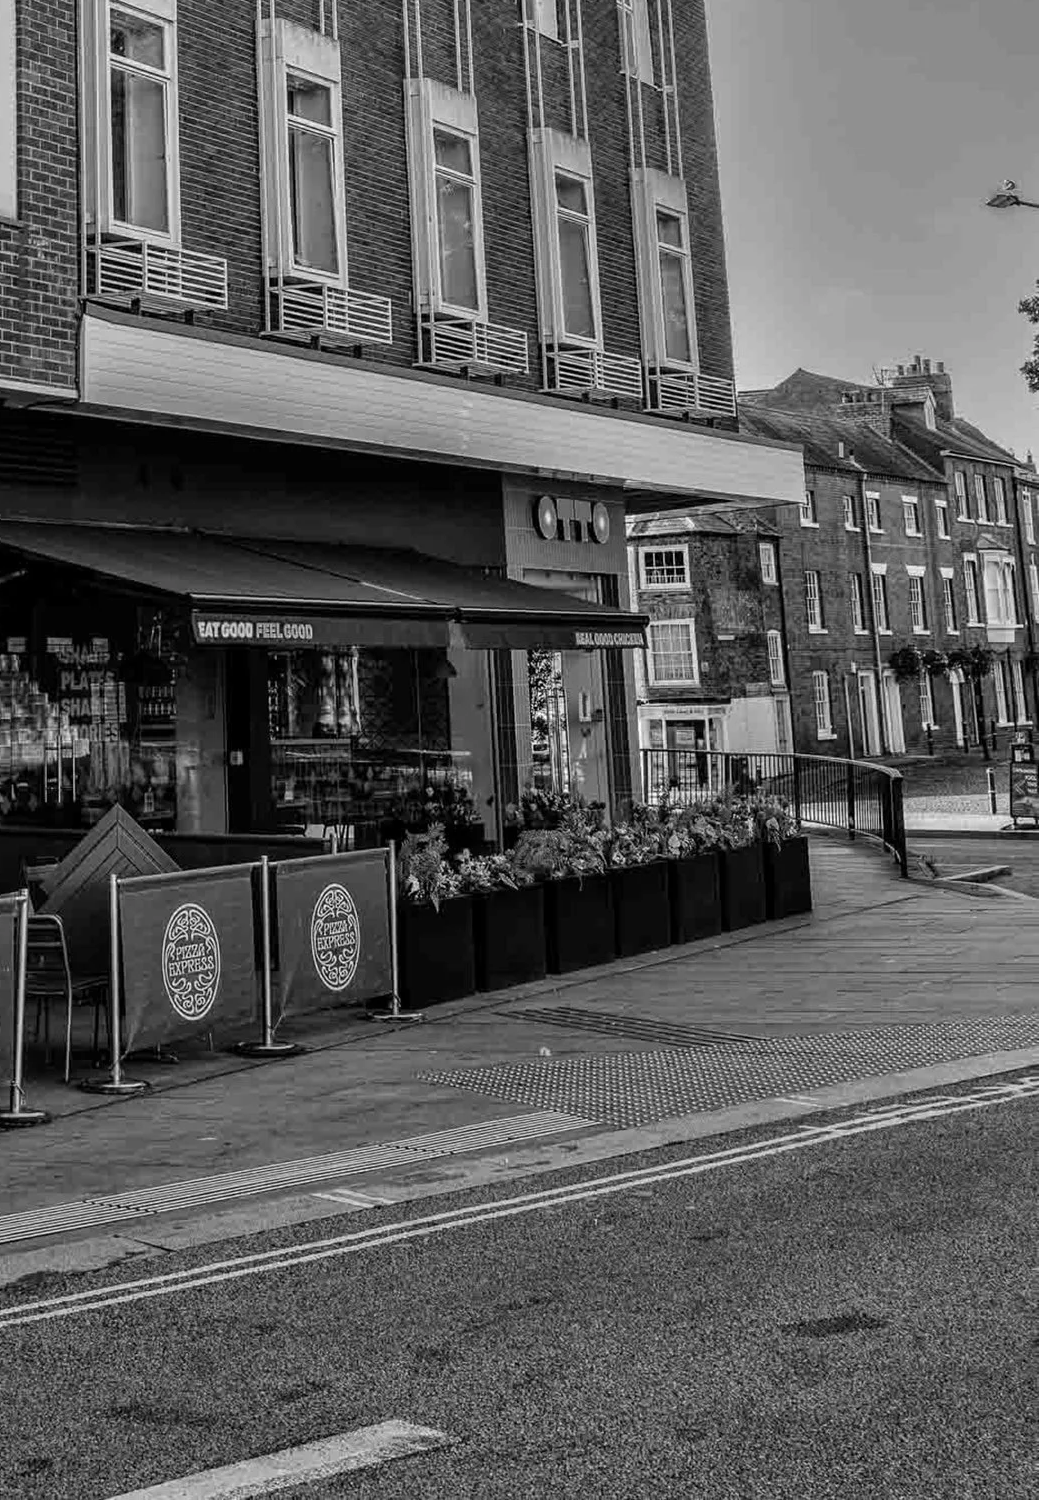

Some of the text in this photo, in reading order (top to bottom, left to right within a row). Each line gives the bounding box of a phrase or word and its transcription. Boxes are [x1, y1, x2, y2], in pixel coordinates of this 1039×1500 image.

[533, 495, 611, 545] OTTO
[197, 621, 313, 640] EAT GOOD FEEL GOOD
[324, 920, 348, 936] PIZZA
[317, 931, 355, 951] EXPRESS
[176, 943, 205, 961] PIZZA
[168, 956, 214, 977] EXPRESS
